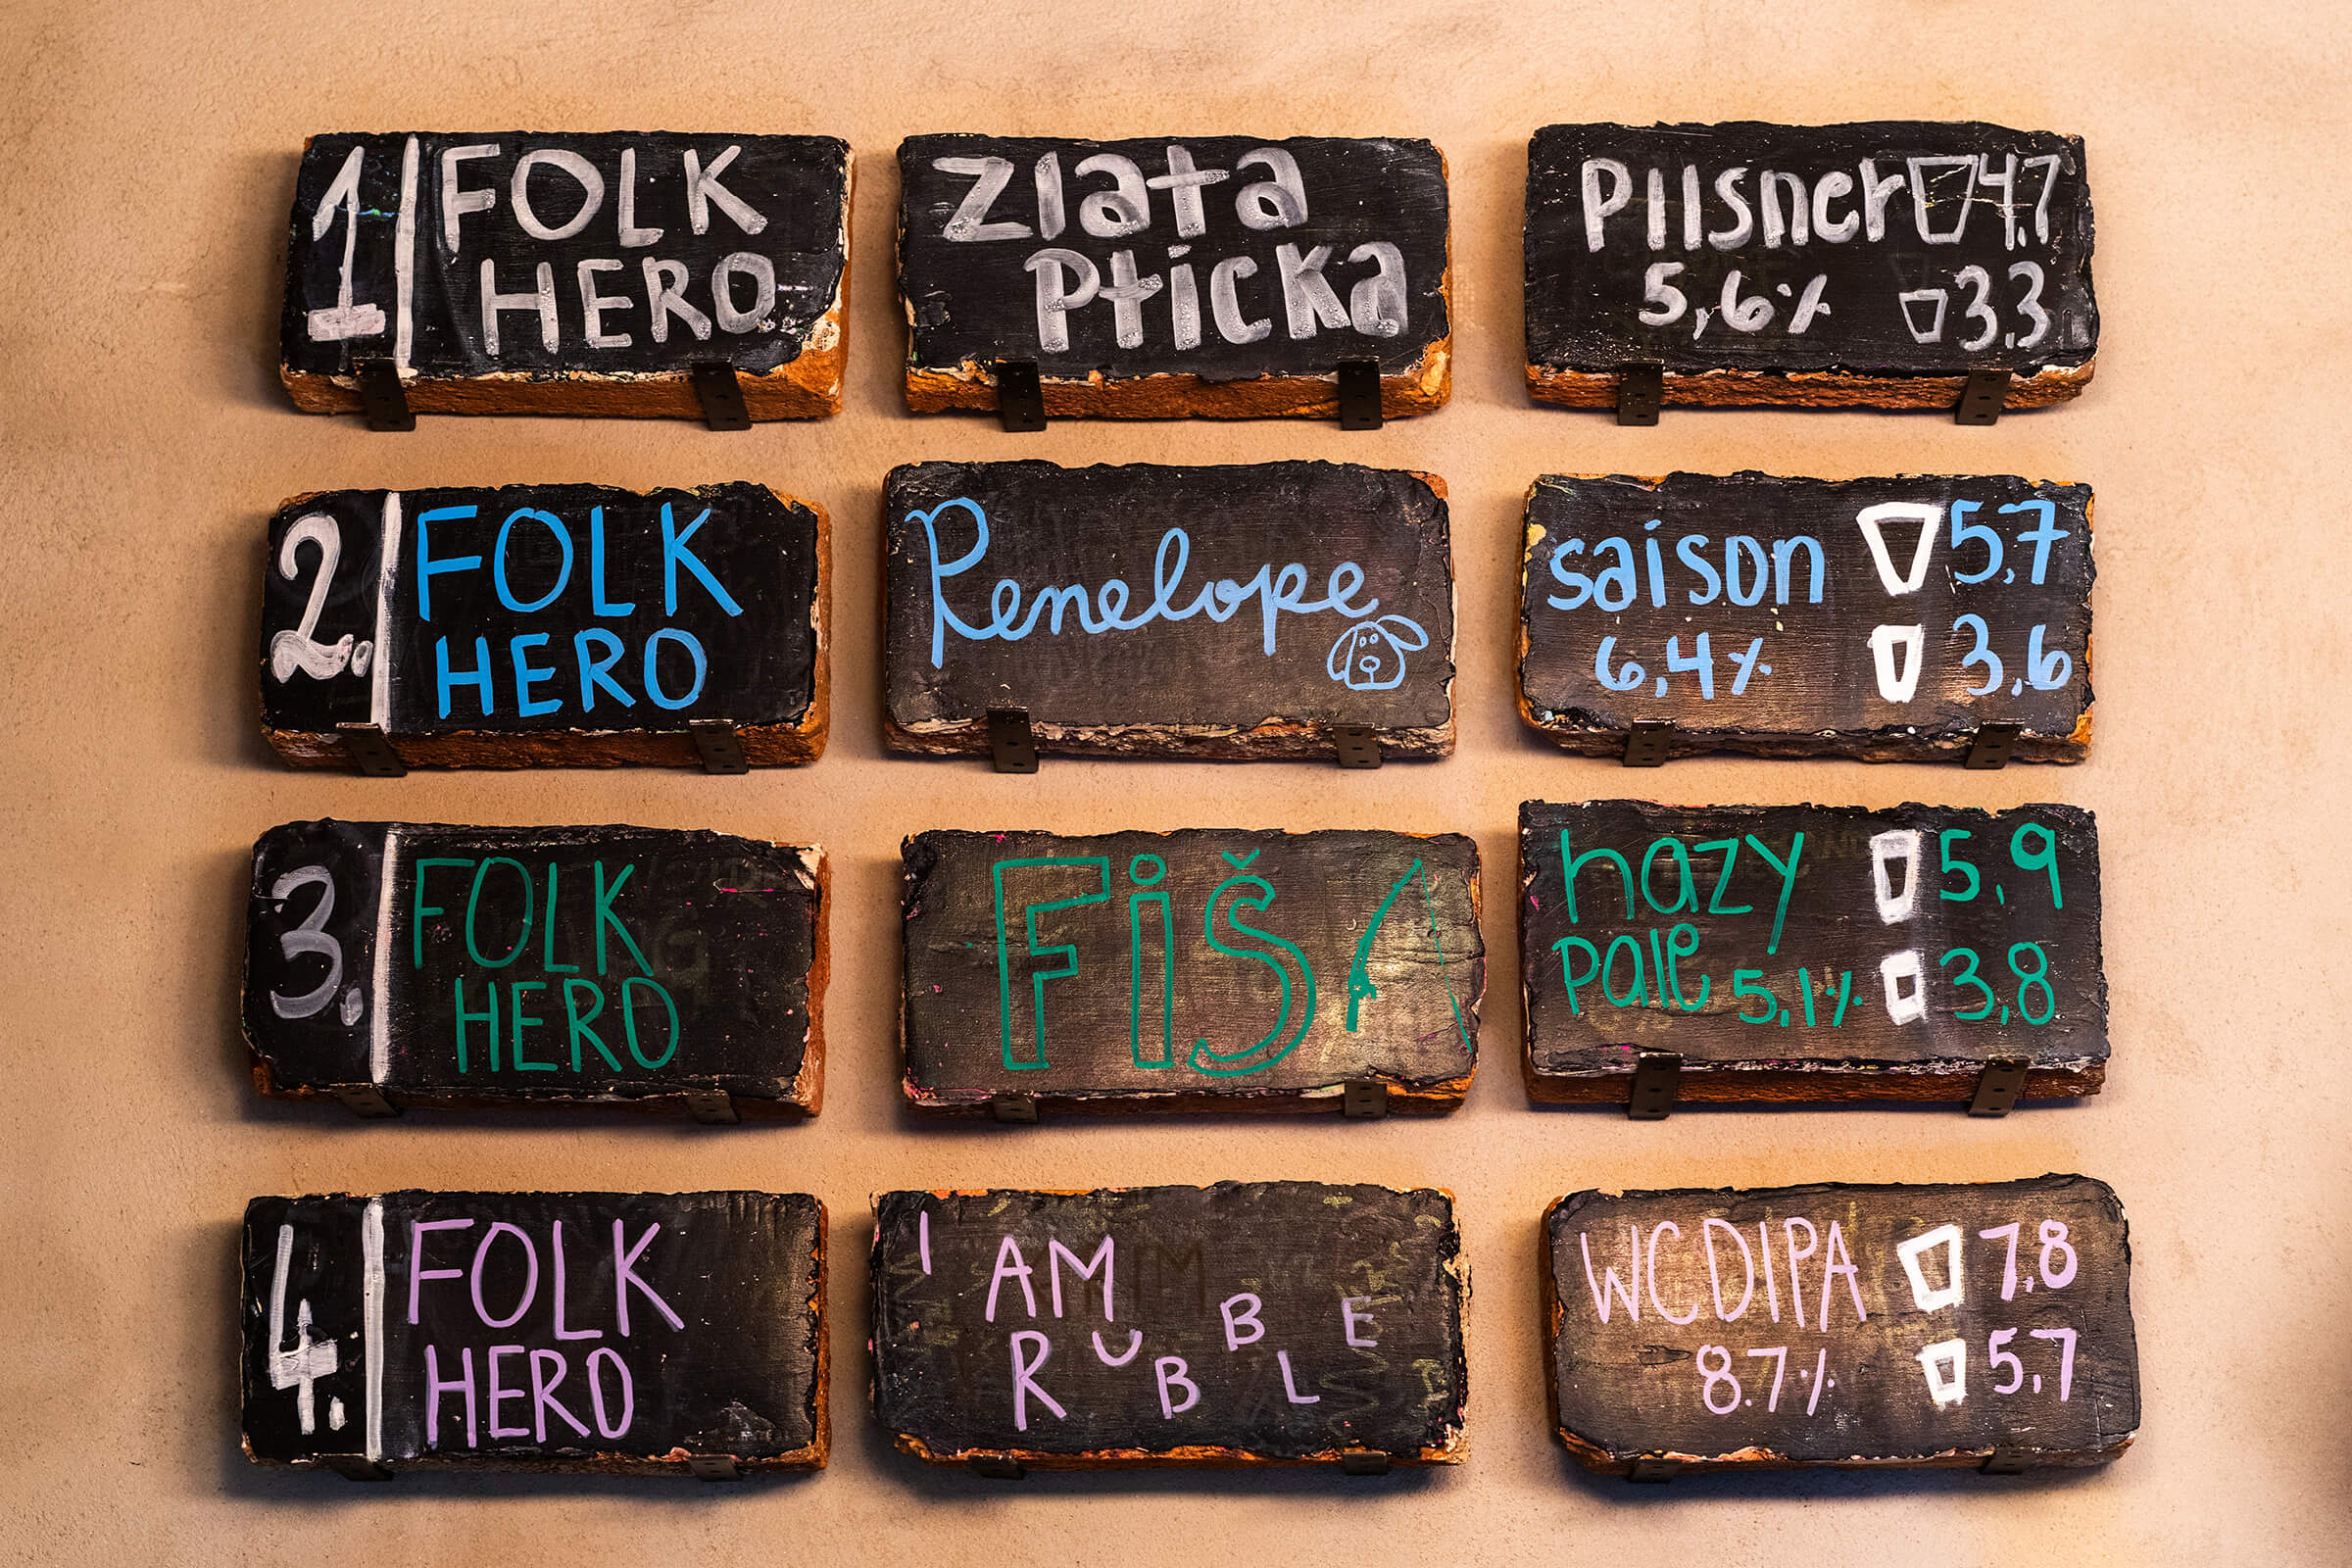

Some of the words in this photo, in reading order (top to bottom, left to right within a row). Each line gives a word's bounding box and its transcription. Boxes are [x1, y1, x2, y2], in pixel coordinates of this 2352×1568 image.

[441, 143, 767, 254] FOLK
[933, 145, 1309, 241] Zlata
[481, 252, 776, 355] HERO
[1023, 241, 1408, 352] Pticka
[271, 513, 372, 683] 2.
[417, 503, 743, 620] FOLK
[905, 497, 1378, 668] Penelope
[1547, 519, 1824, 612] saison
[437, 628, 708, 718] HERO
[270, 864, 362, 1026] 3.
[414, 857, 654, 977] FOLK
[1561, 828, 1804, 955] hazy
[456, 978, 679, 1073] HERO
[408, 1218, 684, 1340] FOLK
[920, 1211, 931, 1274] I
[985, 1235, 1114, 1322] AM
[267, 1224, 345, 1435] 4.
[425, 1345, 633, 1448] HERO
